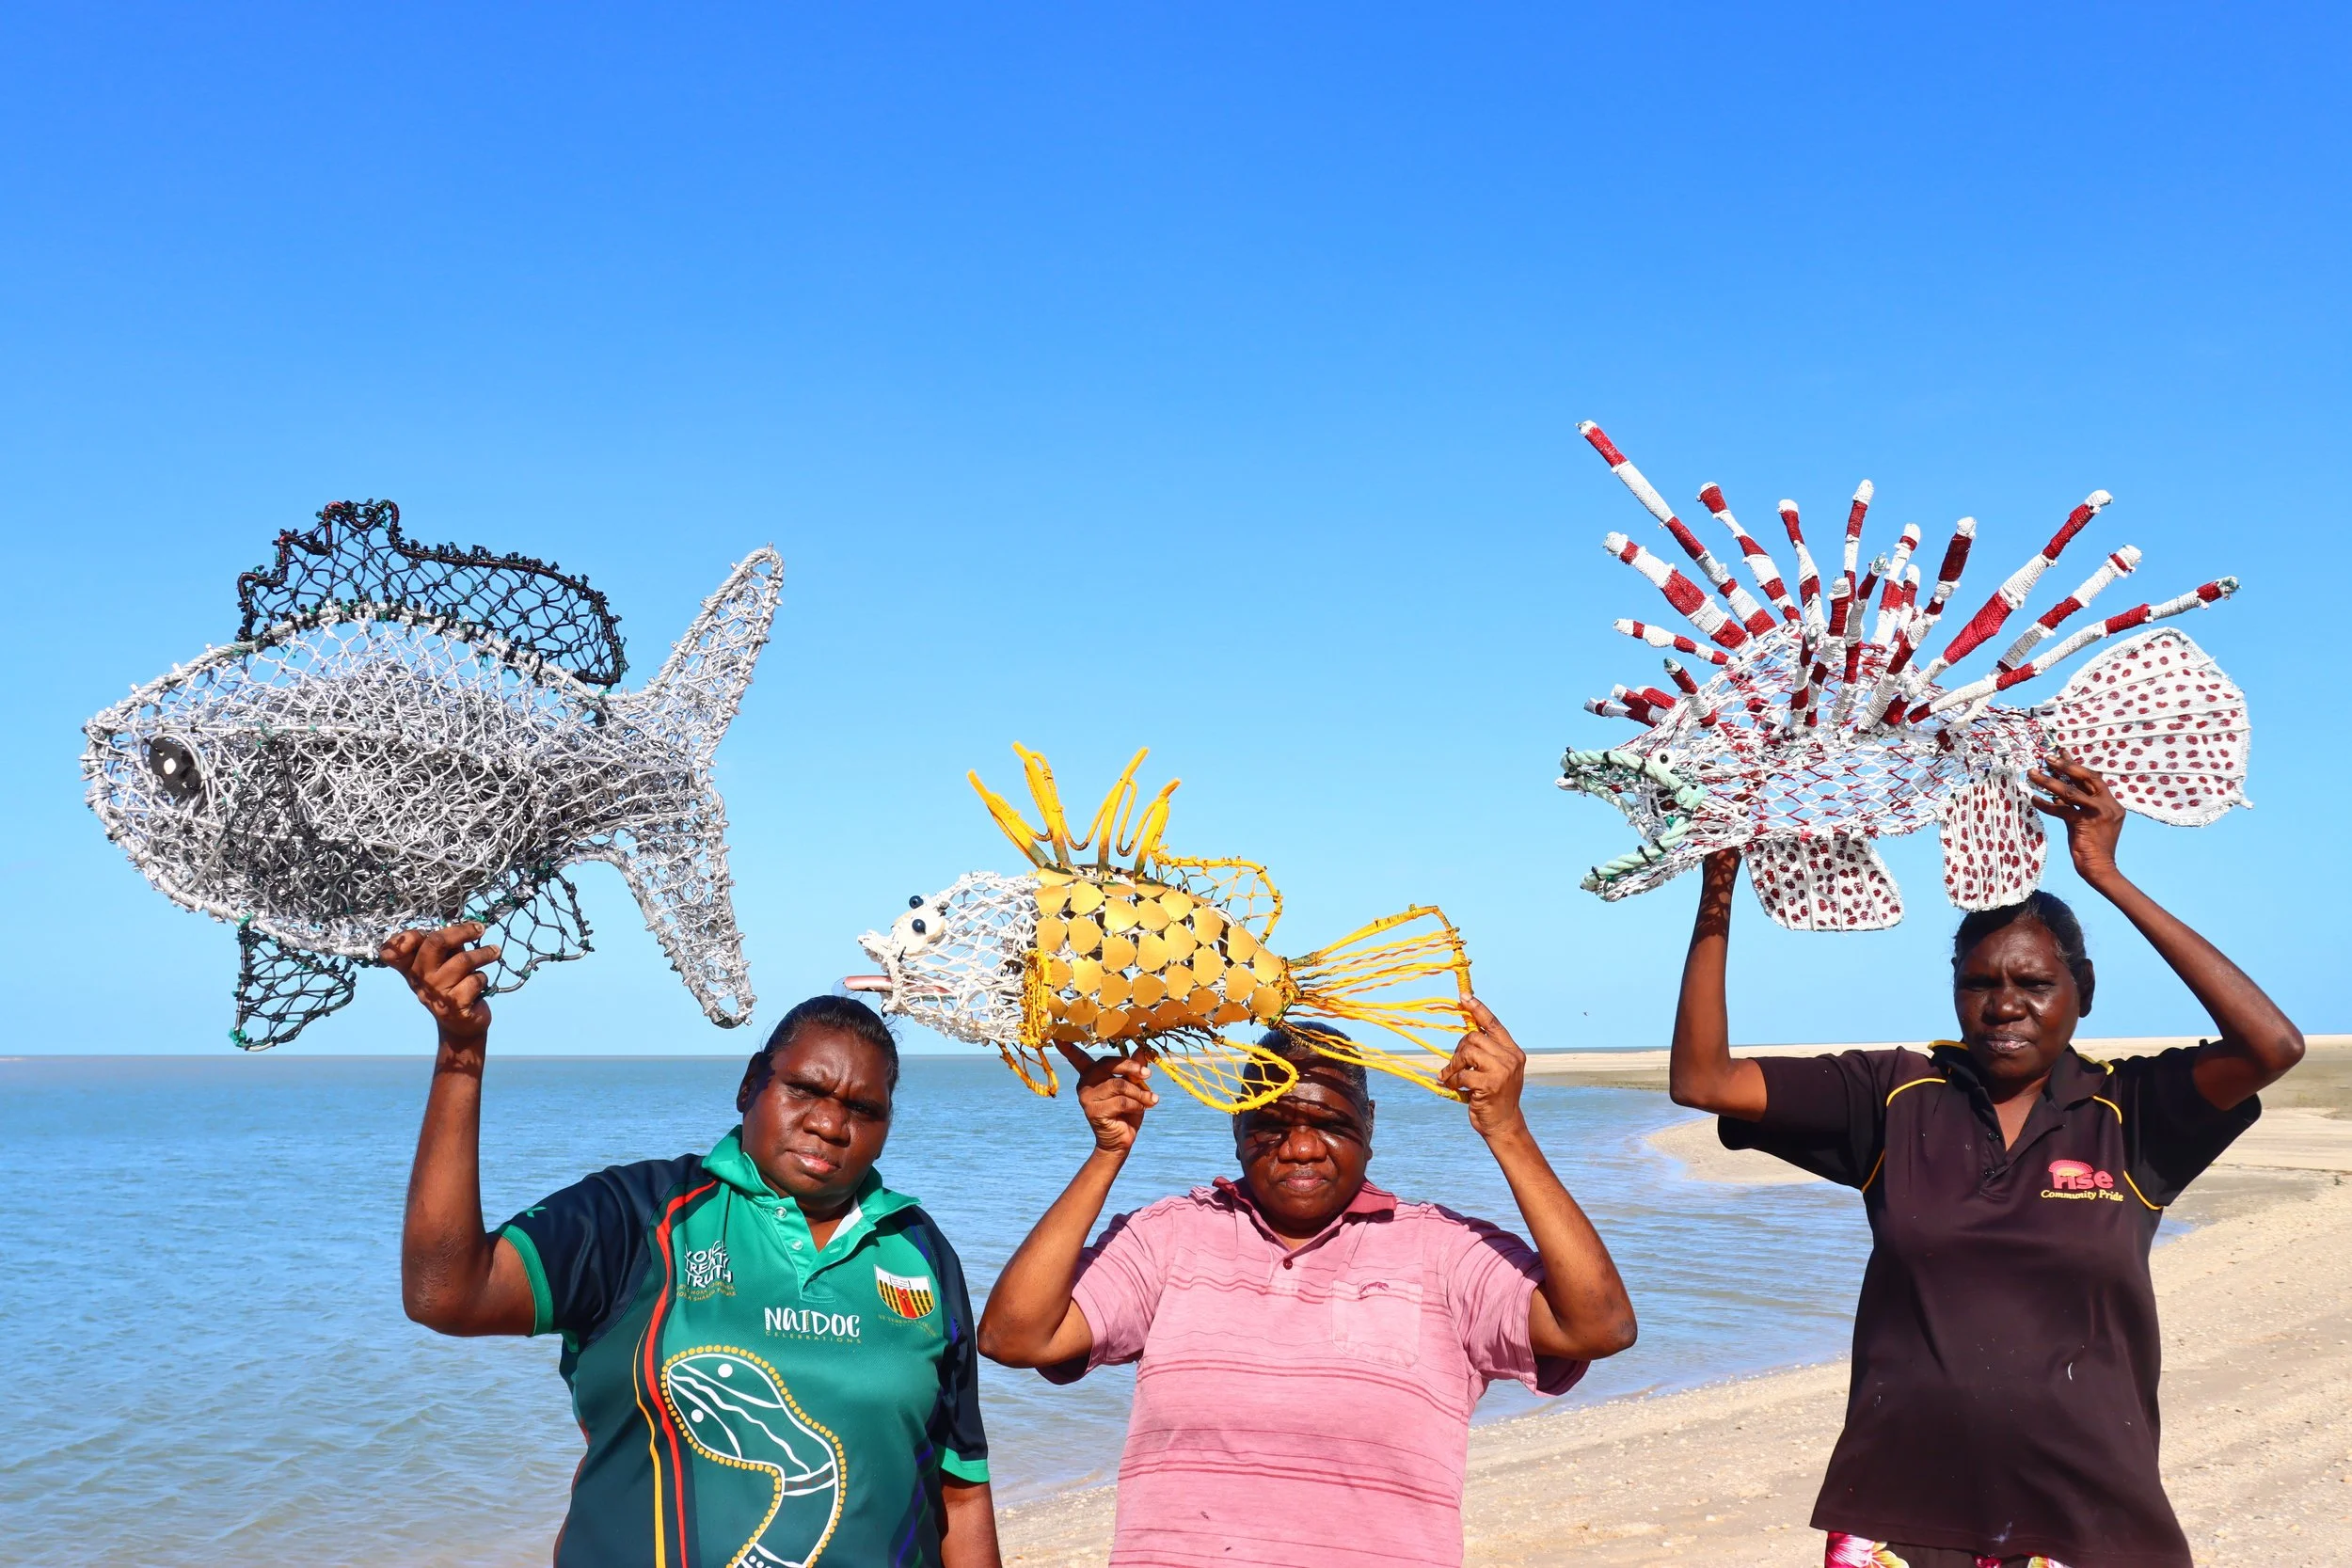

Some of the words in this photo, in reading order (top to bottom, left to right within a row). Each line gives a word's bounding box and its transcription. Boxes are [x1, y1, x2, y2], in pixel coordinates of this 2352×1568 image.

[2041, 1189, 2097, 1200] Community
[2099, 1189, 2124, 1202] Pride
[684, 1252, 729, 1275] TREATY
[685, 1264, 733, 1289] TRUTH
[765, 1330, 862, 1344] CELEBRATIONS
